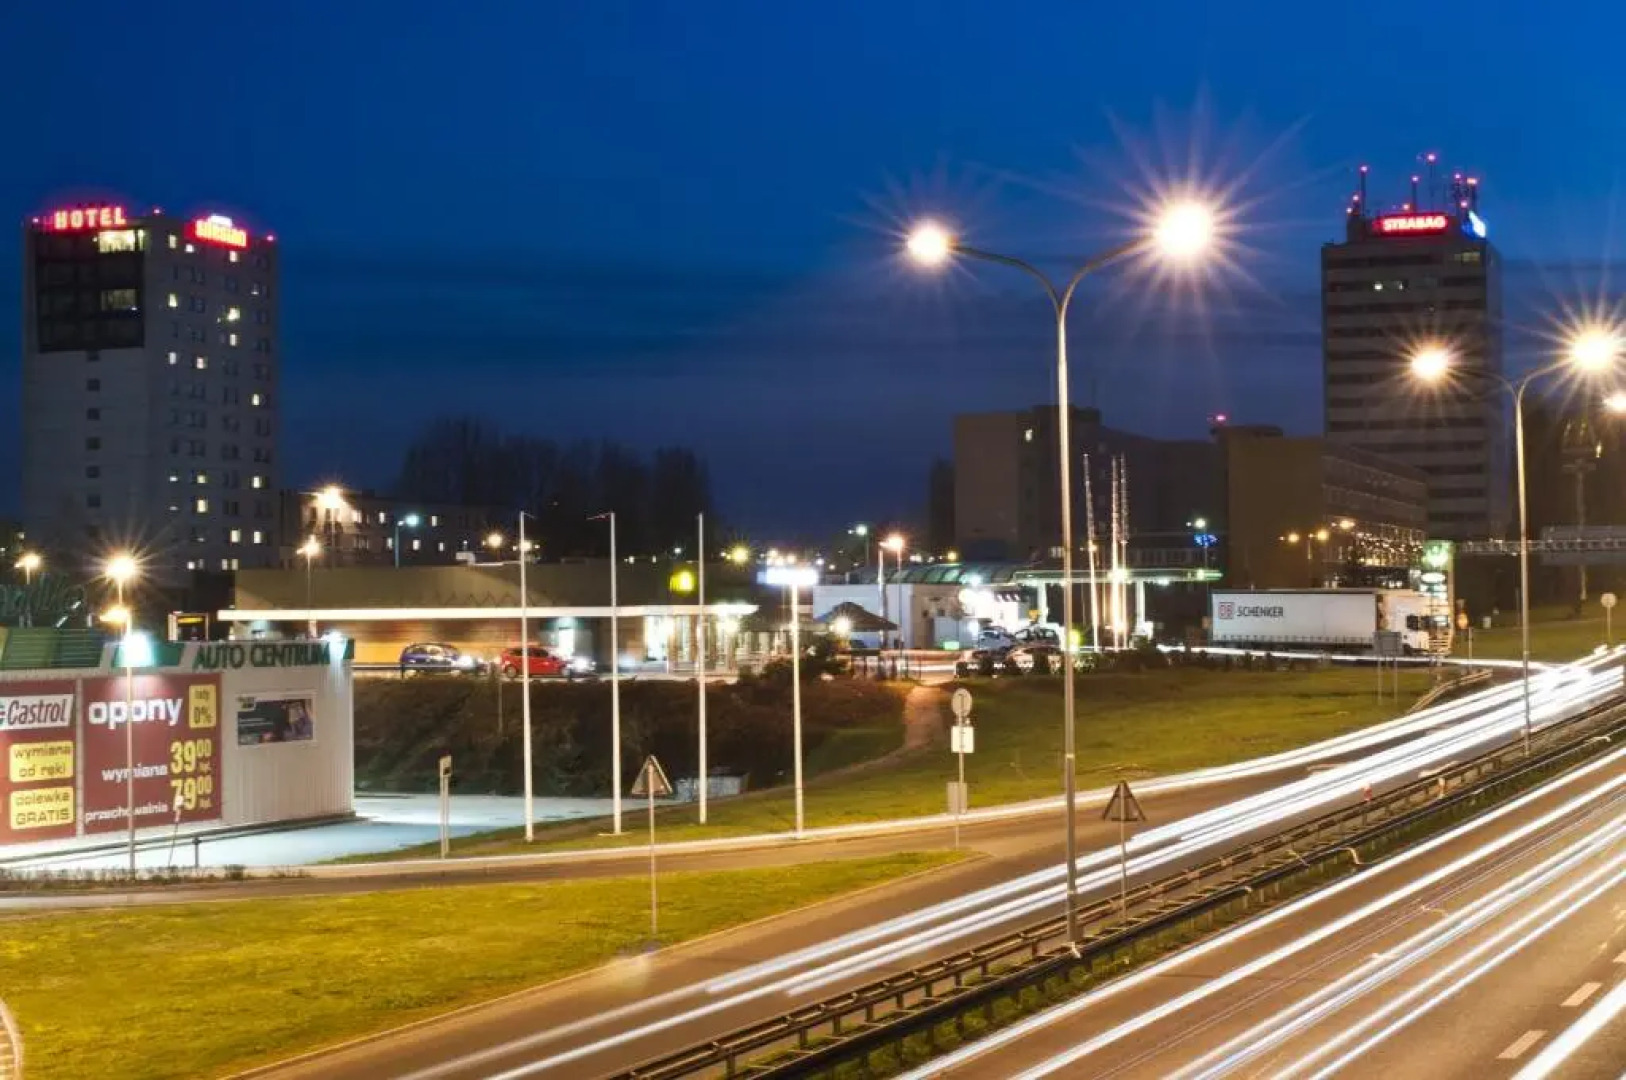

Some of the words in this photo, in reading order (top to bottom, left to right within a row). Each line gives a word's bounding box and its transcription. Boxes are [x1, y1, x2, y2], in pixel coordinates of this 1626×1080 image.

[54, 206, 126, 230] HOTEL
[1237, 606, 1284, 617] SCHENKER
[193, 644, 245, 669] AUTO
[251, 643, 331, 667] CENTRUM
[8, 699, 67, 726] Castrol
[88, 698, 183, 730] opony
[102, 762, 168, 784] wymiana
[16, 808, 70, 825] GRATIS
